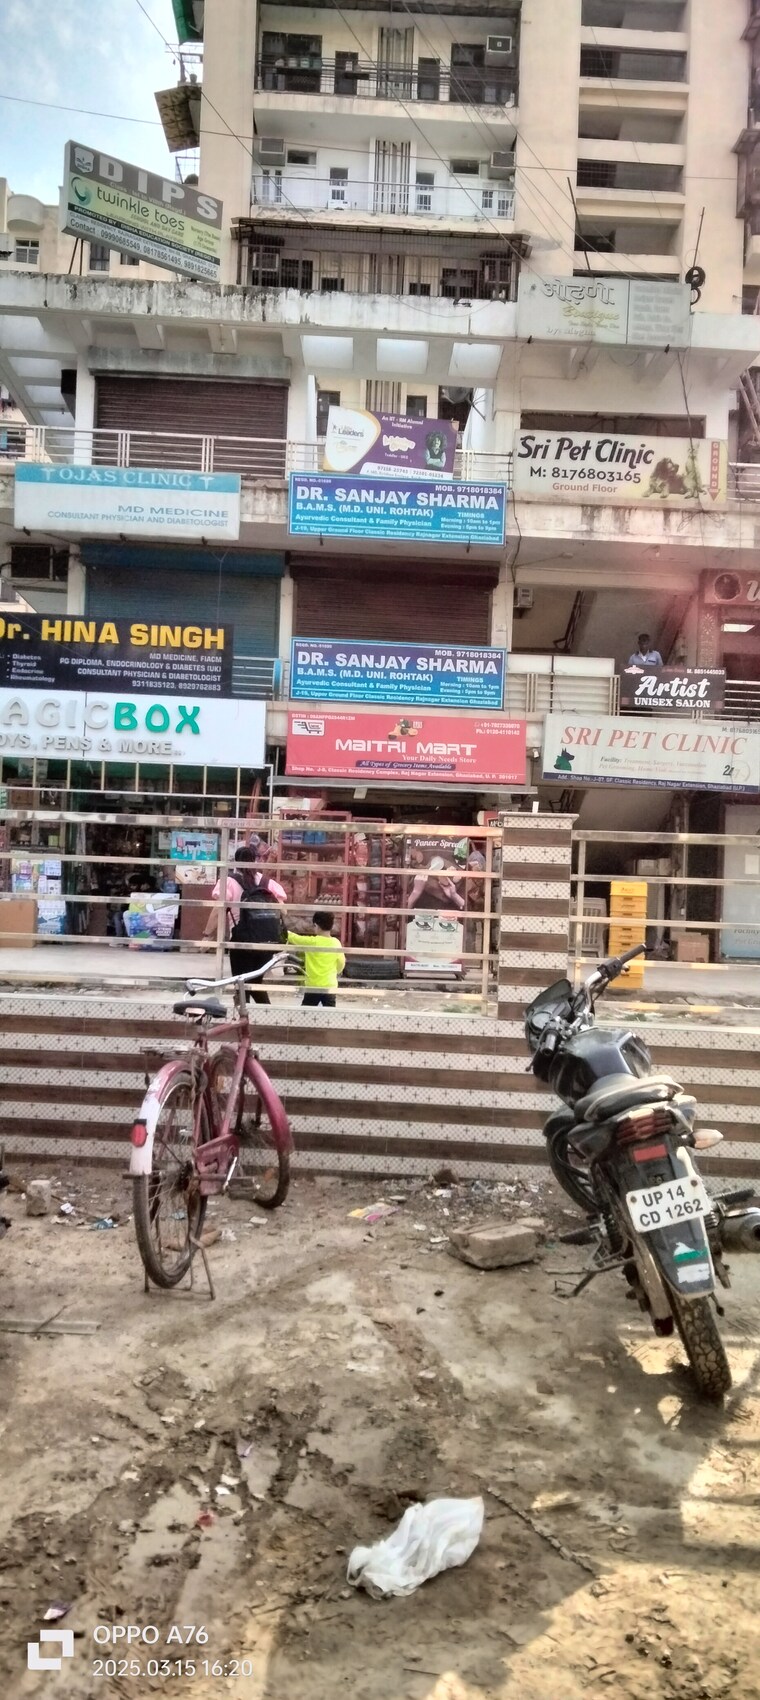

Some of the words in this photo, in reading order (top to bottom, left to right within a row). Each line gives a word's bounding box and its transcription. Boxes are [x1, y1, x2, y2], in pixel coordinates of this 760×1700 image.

[99, 155, 218, 219] DIPS
[97, 186, 150, 217] twinkle
[155, 209, 185, 231] toes
[71, 218, 96, 234] Contact
[74, 205, 107, 221] PROMOTED
[120, 224, 139, 234] DISHA
[140, 230, 170, 245] EDUCATION
[171, 242, 194, 253] SOCIETY
[338, 428, 365, 437] Leaders
[517, 435, 551, 459] Sri
[554, 437, 591, 462] Pet
[595, 438, 655, 469] Clinic
[59, 467, 117, 483] OJAS
[123, 471, 192, 487] CLINIC
[530, 466, 546, 478] M:
[551, 467, 641, 484] 8176803165
[435, 485, 455, 493] MOB.
[457, 487, 502, 495] 9718018384
[552, 482, 589, 492] Ground
[592, 484, 618, 493] Floor
[296, 486, 328, 501] DR.
[335, 488, 411, 505] SANJAY
[416, 492, 499, 510] SHARMA
[118, 505, 144, 513] MD
[150, 507, 229, 518] MEDICINE
[296, 502, 336, 512] B.A.M.S.
[339, 505, 364, 514] (M.D.
[366, 506, 387, 515] UNI.
[390, 507, 434, 519] ROHTAK)
[47, 511, 99, 520] CONSULTANT
[101, 514, 144, 523] PHYSICIAN
[146, 516, 165, 524] AND
[167, 517, 228, 527] DIABETOLOGIST
[295, 514, 329, 522] Ayurvedic
[376, 518, 398, 526] Family
[400, 519, 432, 527] Physician
[0, 617, 30, 640] r.
[41, 619, 120, 644] HINA
[130, 623, 224, 650] SINGH
[71, 658, 105, 666] DIPLOMA,
[106, 659, 164, 669] ENDOCRINOLOGY
[172, 664, 206, 672] DIABETES
[163, 654, 198, 662] MEDICINE,
[200, 655, 222, 663] FIACM
[297, 651, 329, 666] DR.
[335, 653, 410, 669] SANJAY
[416, 656, 498, 674] SHARMA
[10, 674, 55, 682] Rheumatology
[77, 668, 121, 677] CONSULTANT
[123, 670, 160, 679] PHYSICIAN
[169, 673, 221, 682] DIABETOLOGIST
[297, 668, 336, 677] B.A.M.S.
[340, 670, 364, 679] (M.D.
[366, 671, 387, 679] UNI.
[390, 672, 433, 683] ROHTAK)
[296, 679, 329, 687] Ayurvedic
[400, 684, 431, 692] Physician
[634, 675, 710, 698] Artist
[634, 697, 673, 707] UNISEX
[676, 699, 711, 708] SALON
[0, 733, 37, 751] OYS,
[42, 735, 92, 751] PENS
[99, 738, 112, 752] &
[560, 726, 603, 746] SRI
[608, 729, 656, 749] PET
[661, 732, 748, 755] CLINIC
[420, 755, 436, 763] Daily
[414, 839, 438, 847] Paneer
[440, 839, 465, 848] Spread
[642, 1191, 664, 1208] UP
[666, 1185, 685, 1200] 14
[639, 1211, 661, 1227] CD
[666, 1198, 704, 1220] 1262
